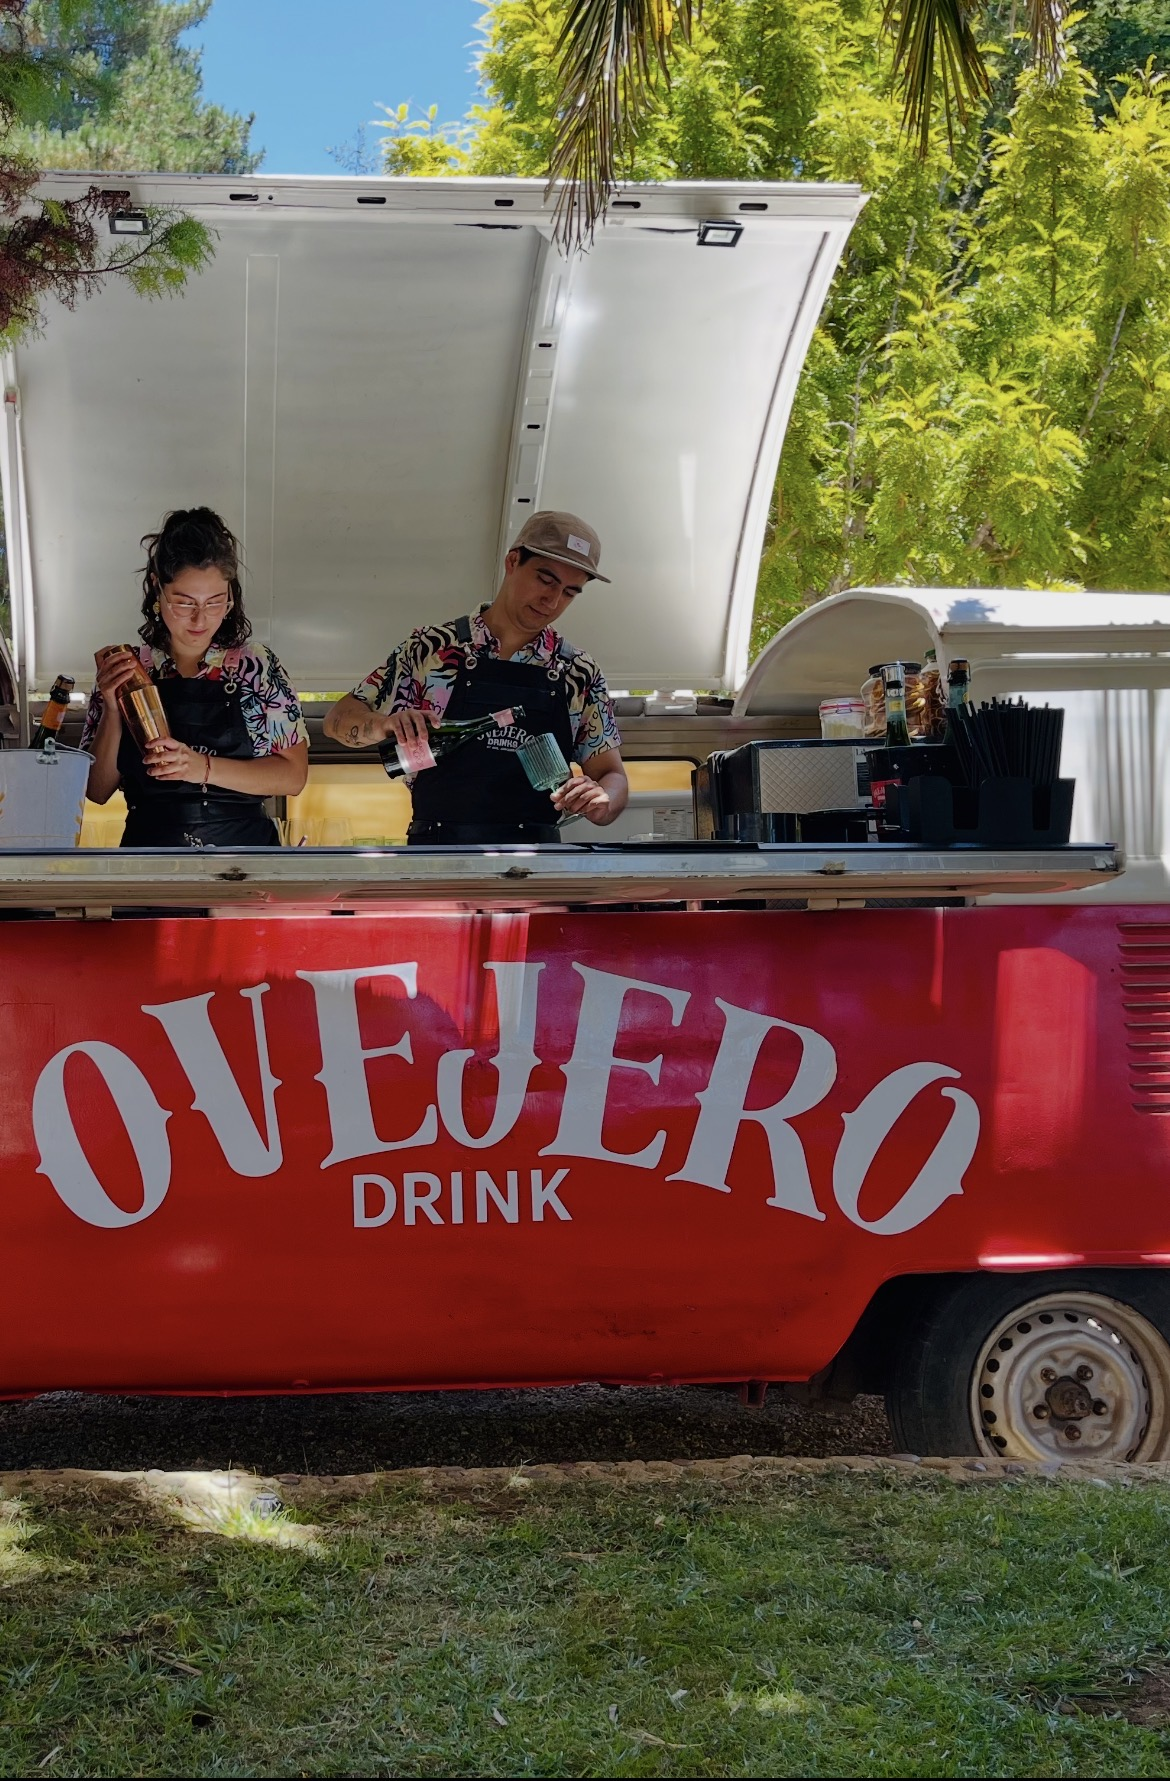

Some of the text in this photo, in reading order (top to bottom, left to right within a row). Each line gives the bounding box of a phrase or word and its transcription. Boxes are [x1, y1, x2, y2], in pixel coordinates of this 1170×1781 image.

[487, 738, 519, 749] DRINKS
[32, 961, 981, 1236] OVEJERO
[353, 1169, 572, 1229] DRINK
